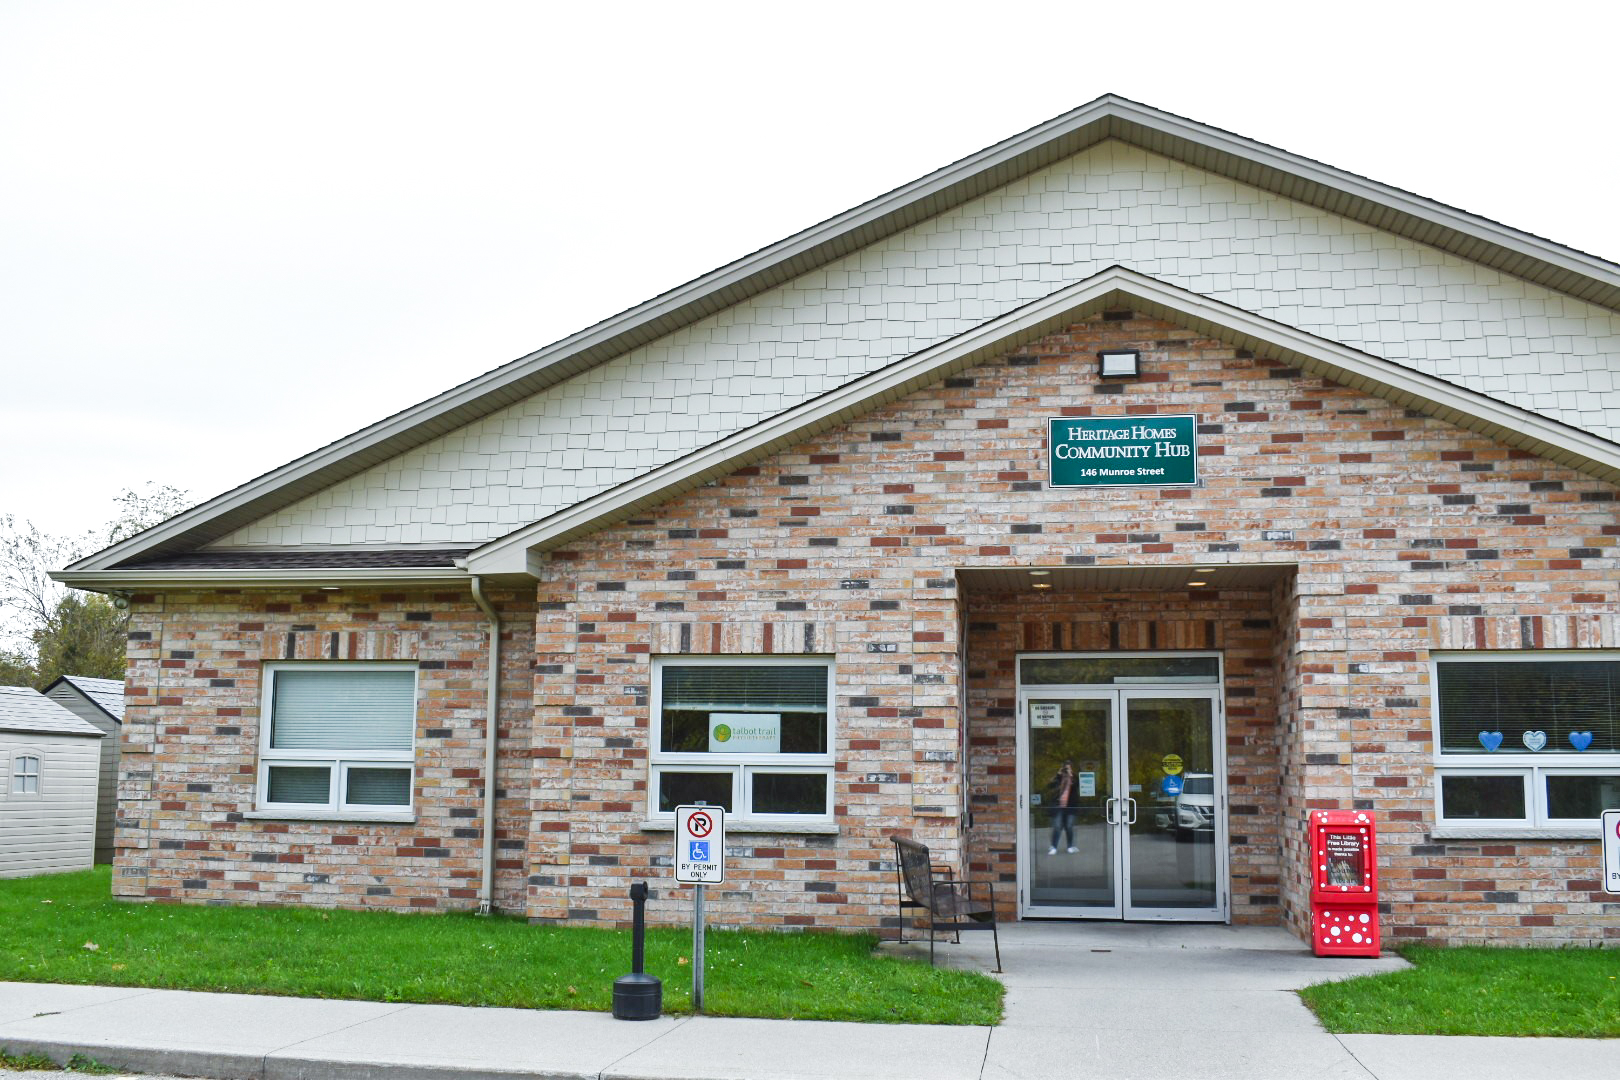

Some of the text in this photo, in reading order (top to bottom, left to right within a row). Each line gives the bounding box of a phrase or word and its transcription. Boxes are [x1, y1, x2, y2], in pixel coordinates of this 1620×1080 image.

[1067, 426, 1177, 441] HERITAGE HOMES
[1055, 441, 1191, 459] COMMUNITY HUB
[1080, 467, 1165, 477] 146 Munroe Street
[733, 727, 776, 735] talbot trail
[693, 863, 718, 871] PERMIT
